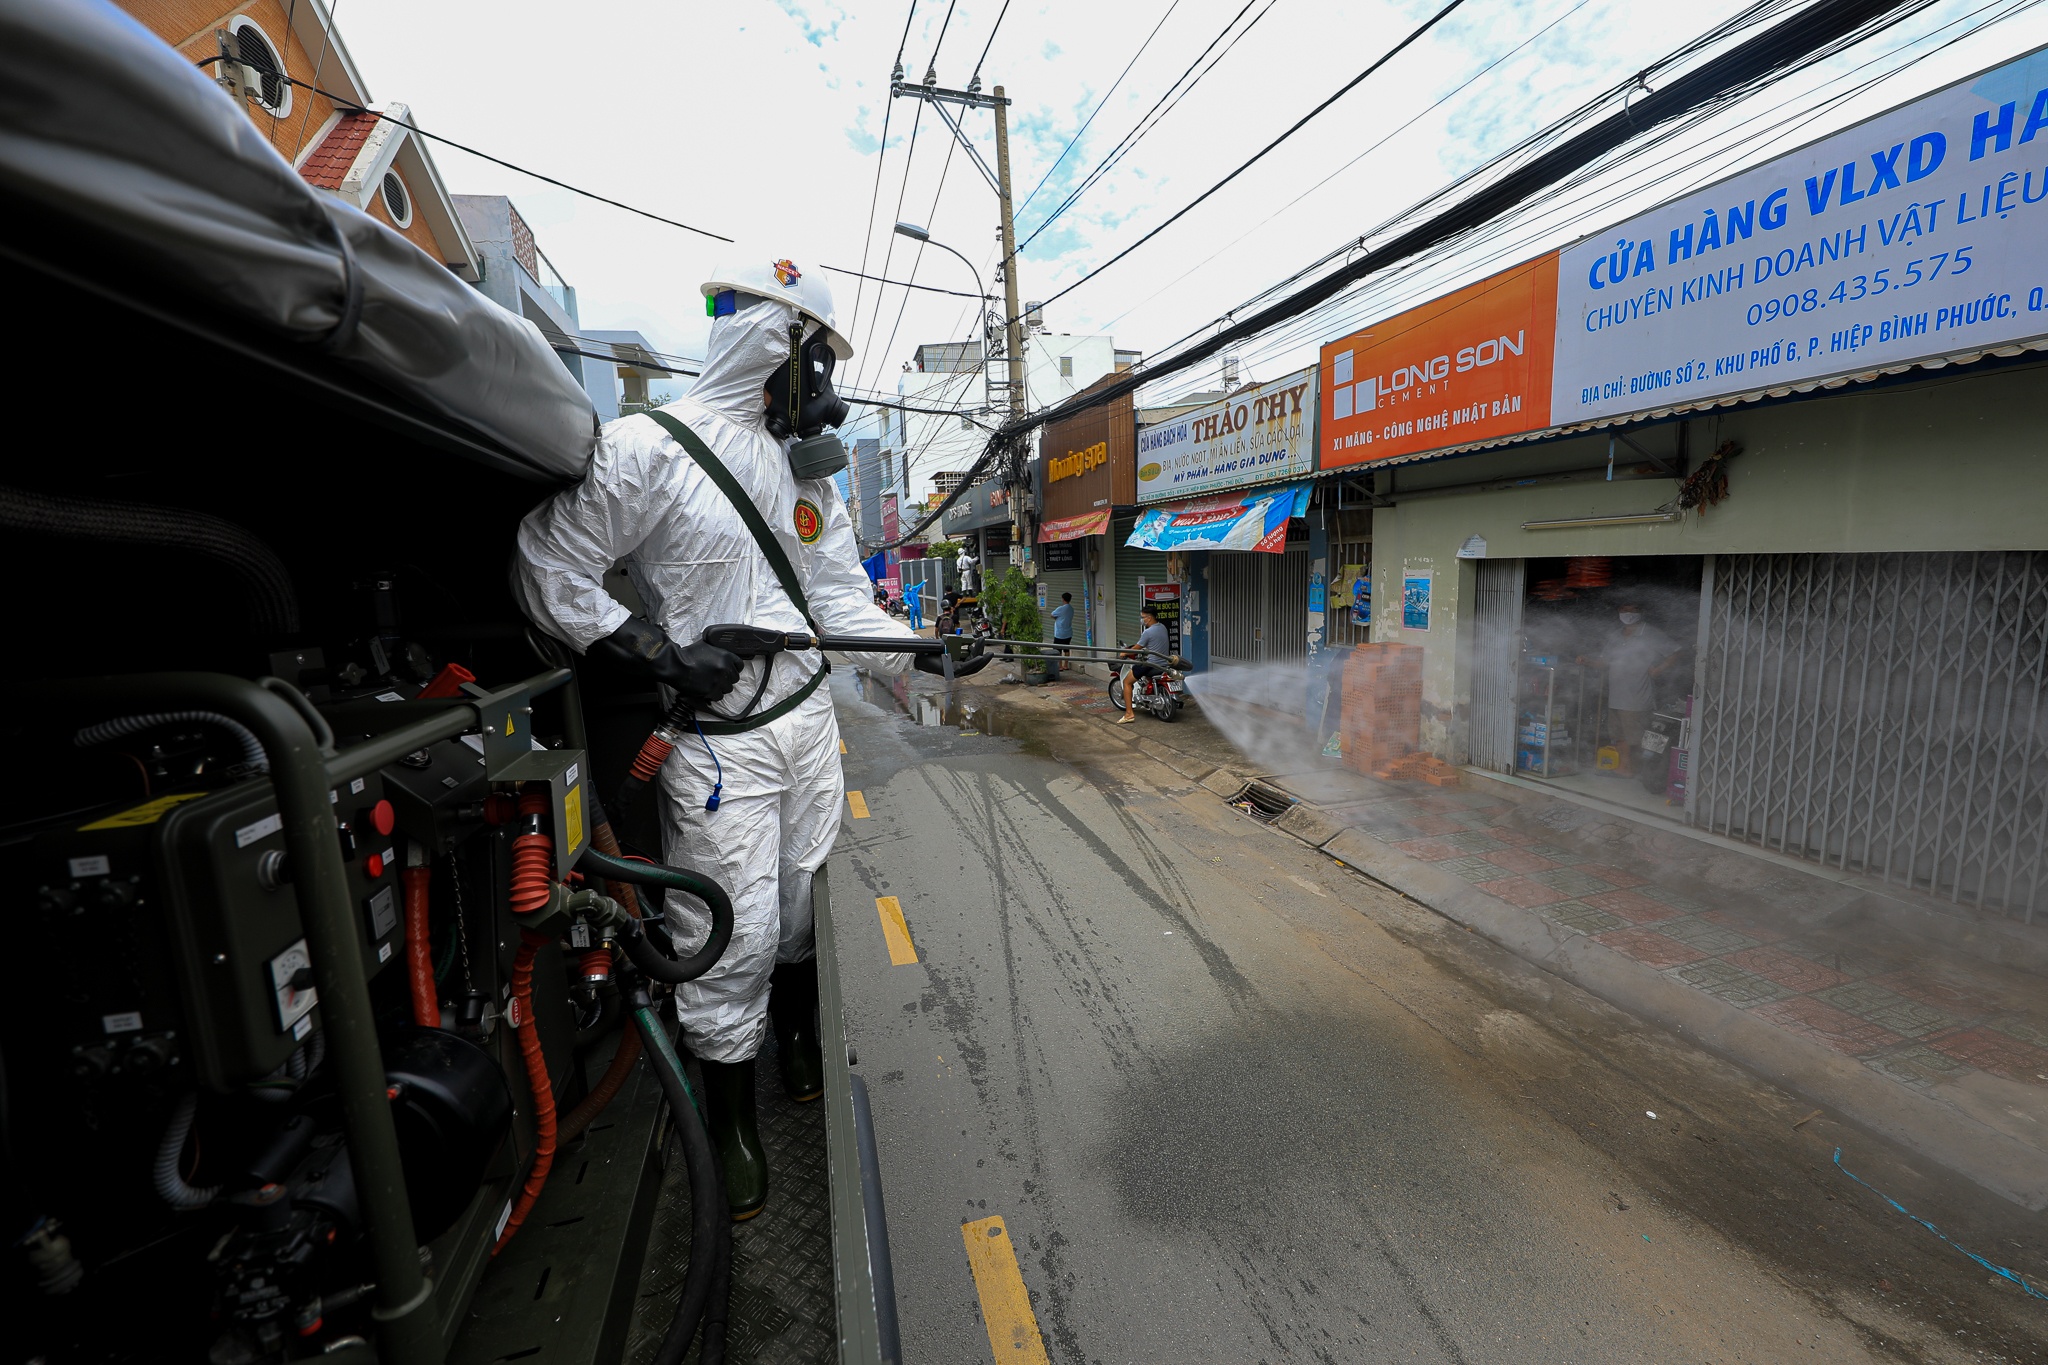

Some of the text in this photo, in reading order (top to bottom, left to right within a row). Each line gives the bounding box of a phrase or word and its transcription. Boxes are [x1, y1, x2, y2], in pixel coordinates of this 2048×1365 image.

[1588, 238, 1656, 290] CỬA
[1668, 187, 1788, 266] HÀNG
[1804, 131, 1947, 216] VLXD
[1586, 165, 2048, 333] CHUYÊN KINH DOANH VẬT LIỆU
[1746, 245, 1974, 327] 0908.435.575
[1378, 329, 1525, 396] LONG SON
[1582, 386, 1600, 405] ĐỊA
[1603, 375, 1626, 400] CHỈ:
[1630, 369, 1672, 394] ĐƯỜNG
[1676, 359, 1695, 385] SỐ
[1697, 361, 1710, 381] 2,
[1715, 353, 1745, 377] KHU
[1749, 338, 1784, 370] PHỐ
[1786, 342, 1801, 363] 6,
[1808, 336, 1823, 358] P.
[1831, 323, 1873, 354] HIỆP
[1879, 312, 1928, 343] BÌNH
[1935, 292, 2017, 332] PHƯỚC,
[1191, 382, 1308, 444] THẢO THY
[1333, 437, 1343, 451] XI
[1345, 429, 1373, 448] MĂNG
[1383, 421, 1413, 440] CÔNG
[1416, 410, 1449, 431] NGHỆ
[1453, 402, 1488, 425] NHẬT
[1492, 393, 1521, 417] BẢN
[1378, 379, 1449, 408] CEMENT
[1214, 459, 1238, 475] HÀNG
[1239, 454, 1256, 468] GIA
[1258, 448, 1287, 467] DỤNG
[1260, 536, 1268, 547] số
[1266, 541, 1274, 550] có
